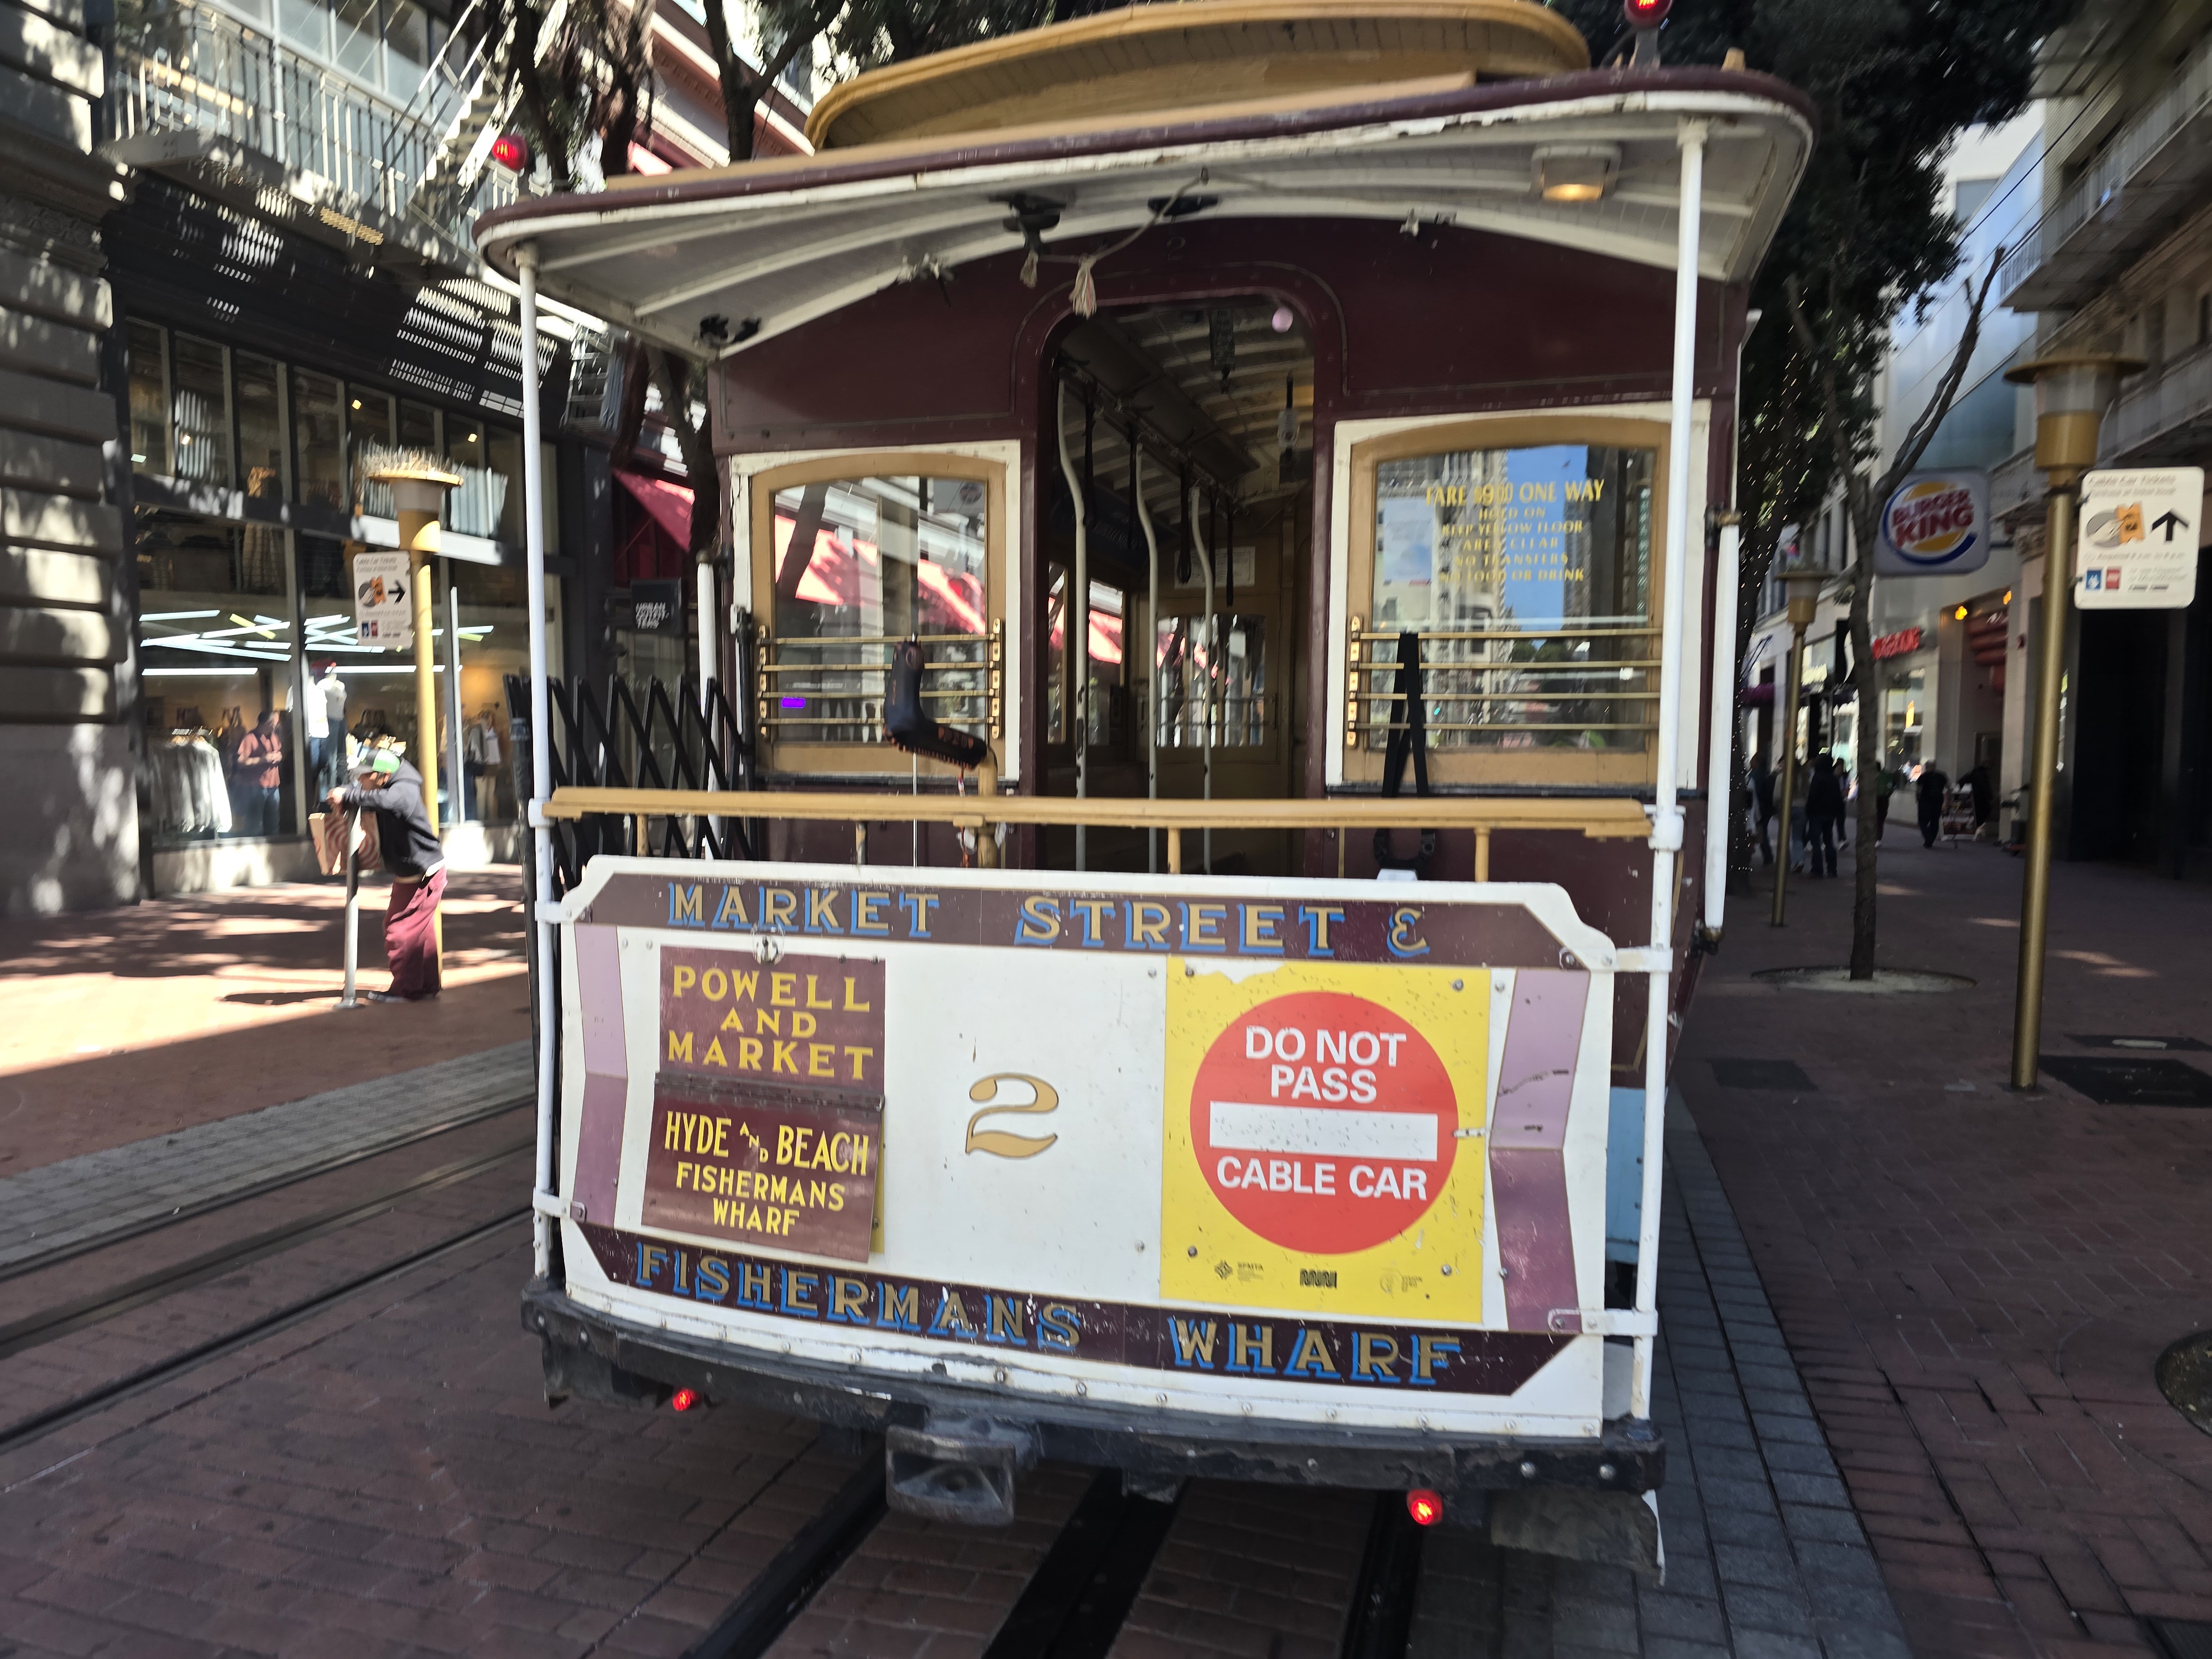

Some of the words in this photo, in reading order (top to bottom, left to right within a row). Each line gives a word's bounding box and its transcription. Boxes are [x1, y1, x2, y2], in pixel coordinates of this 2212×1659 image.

[1167, 236, 1186, 260] 2
[1426, 485, 1468, 507] FARE
[1519, 481, 1557, 504] ONE
[1564, 478, 1605, 503] WAY
[1479, 506, 1519, 521] HOLD
[1524, 506, 1546, 520] ON
[1892, 489, 1971, 528] BURGER
[1896, 505, 1974, 549] KING
[1537, 567, 1584, 582] DRINK
[667, 881, 939, 937] MARKET
[1015, 893, 1345, 956] STREET
[1387, 907, 1431, 957] &
[672, 965, 871, 1013] POWELL
[720, 1006, 817, 1039] AND
[668, 1031, 874, 1081] MARKET
[1245, 1025, 1306, 1062] DO
[1316, 1029, 1407, 1066] NOT
[1270, 1063, 1378, 1104] PASS
[965, 1072, 1059, 1159] 2
[664, 1111, 732, 1158] HYDE
[739, 1120, 769, 1163] AND
[776, 1125, 869, 1176] BEACH
[676, 1165, 847, 1212] FISHERMANS
[1217, 1156, 1335, 1196] CABLE
[1348, 1165, 1427, 1202] CAR
[713, 1197, 800, 1237] WHARF
[635, 1240, 1082, 1353] FISHERMANS
[1168, 1314, 1462, 1386] WHARF
